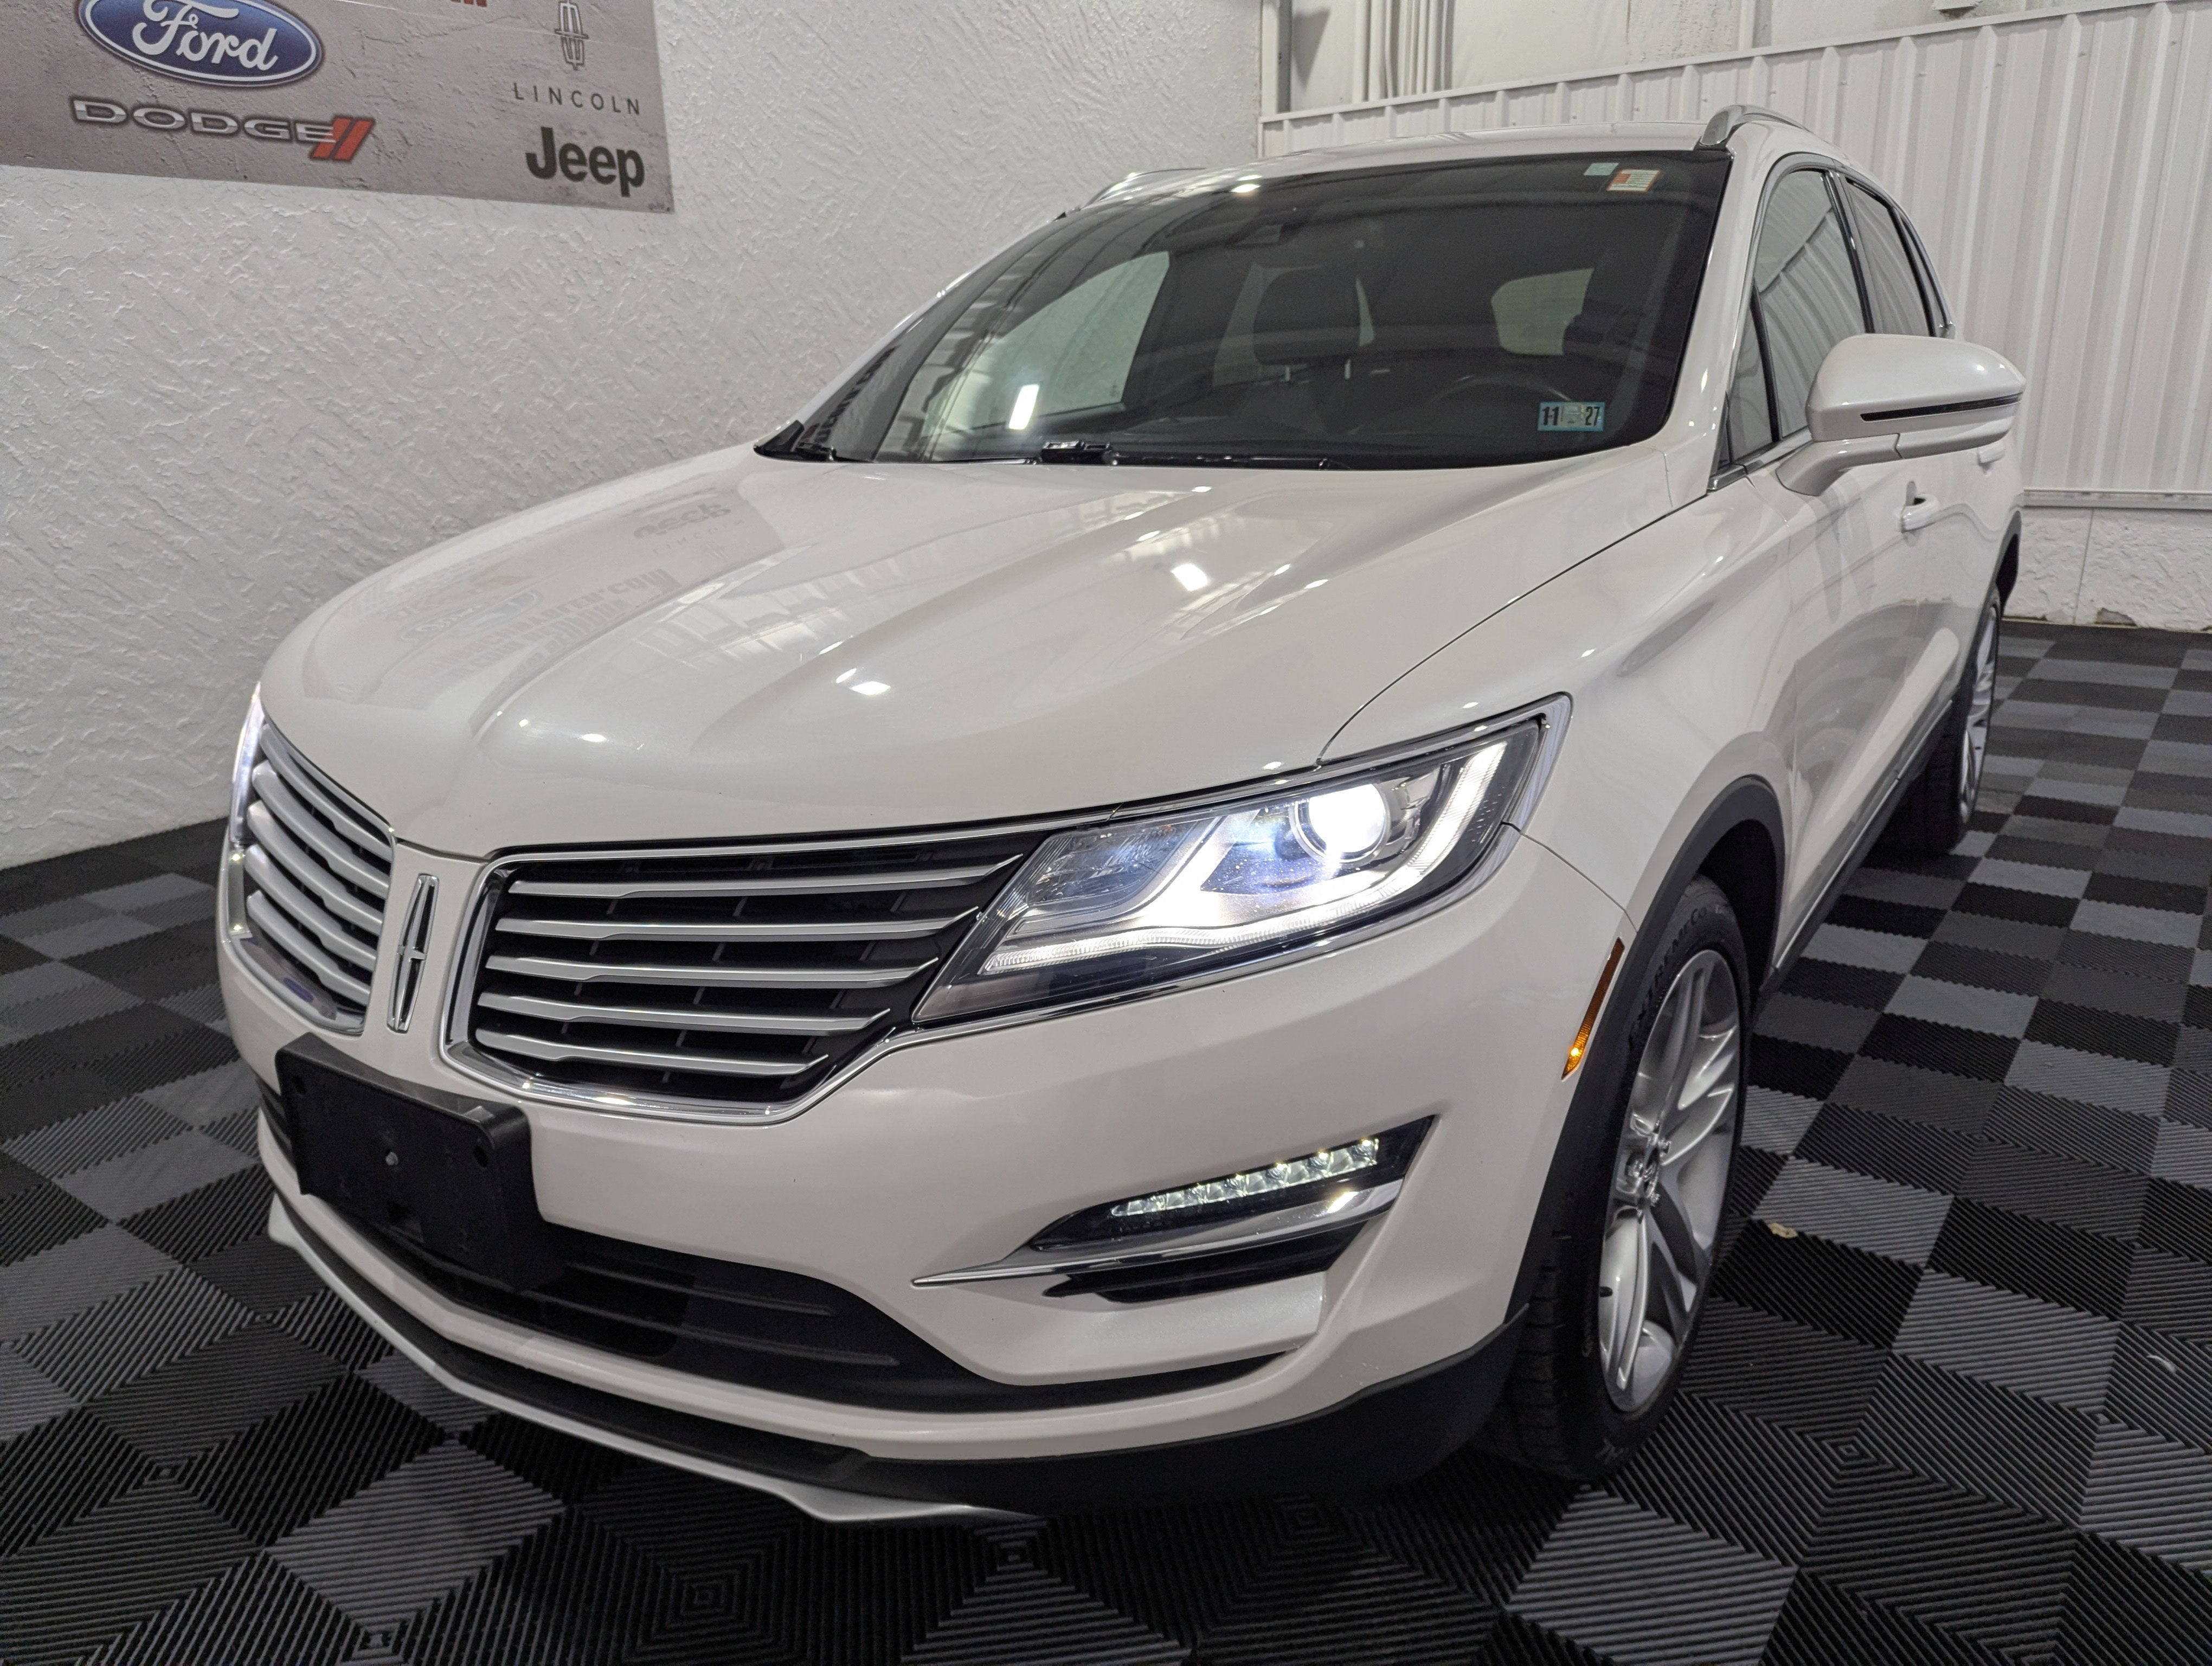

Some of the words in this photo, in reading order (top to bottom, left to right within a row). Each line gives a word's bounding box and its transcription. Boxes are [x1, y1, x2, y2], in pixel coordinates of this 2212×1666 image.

[132, 0, 278, 71] Ford
[72, 99, 337, 144] DODGE
[513, 82, 640, 116] LINCOLN
[525, 126, 645, 198] Jeep
[1585, 406, 1600, 426] 27
